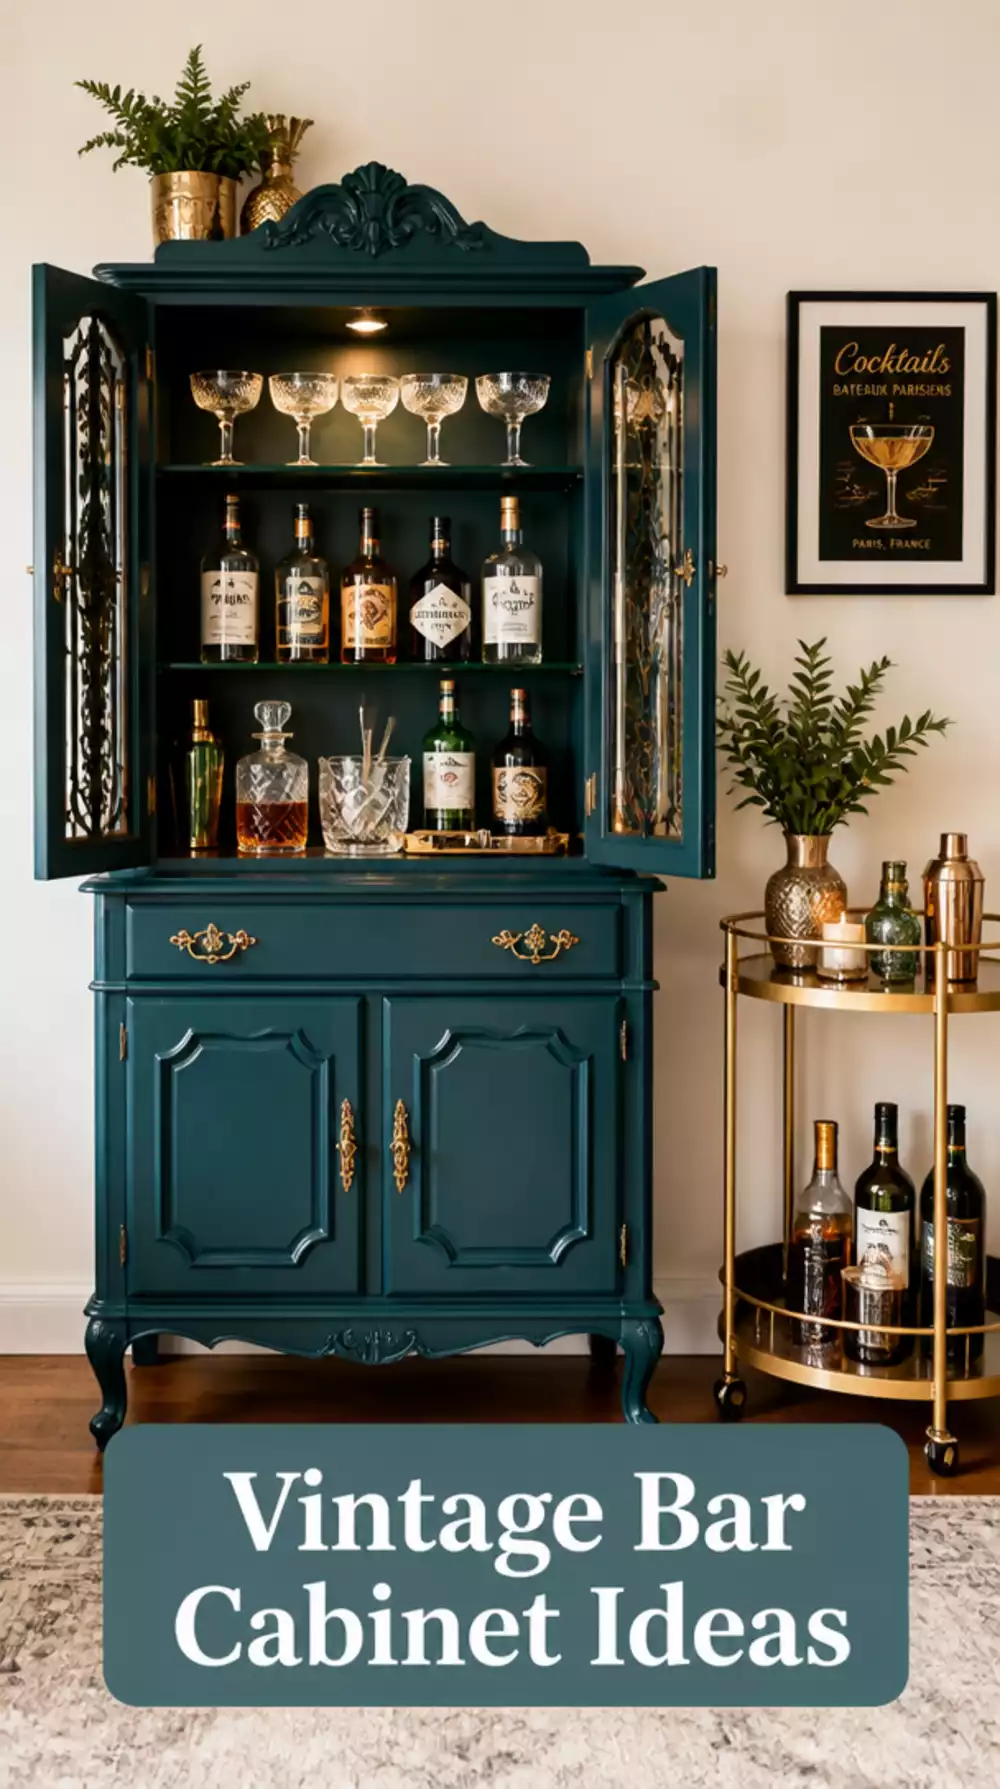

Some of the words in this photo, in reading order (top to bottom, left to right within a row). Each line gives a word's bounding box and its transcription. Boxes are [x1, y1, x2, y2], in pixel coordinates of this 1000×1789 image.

[834, 341, 950, 375] Cocktails
[833, 384, 887, 396] BATEAUX
[892, 384, 951, 396] PARISIENS
[852, 539, 887, 550] PARIS,
[890, 539, 931, 549] FRANCE
